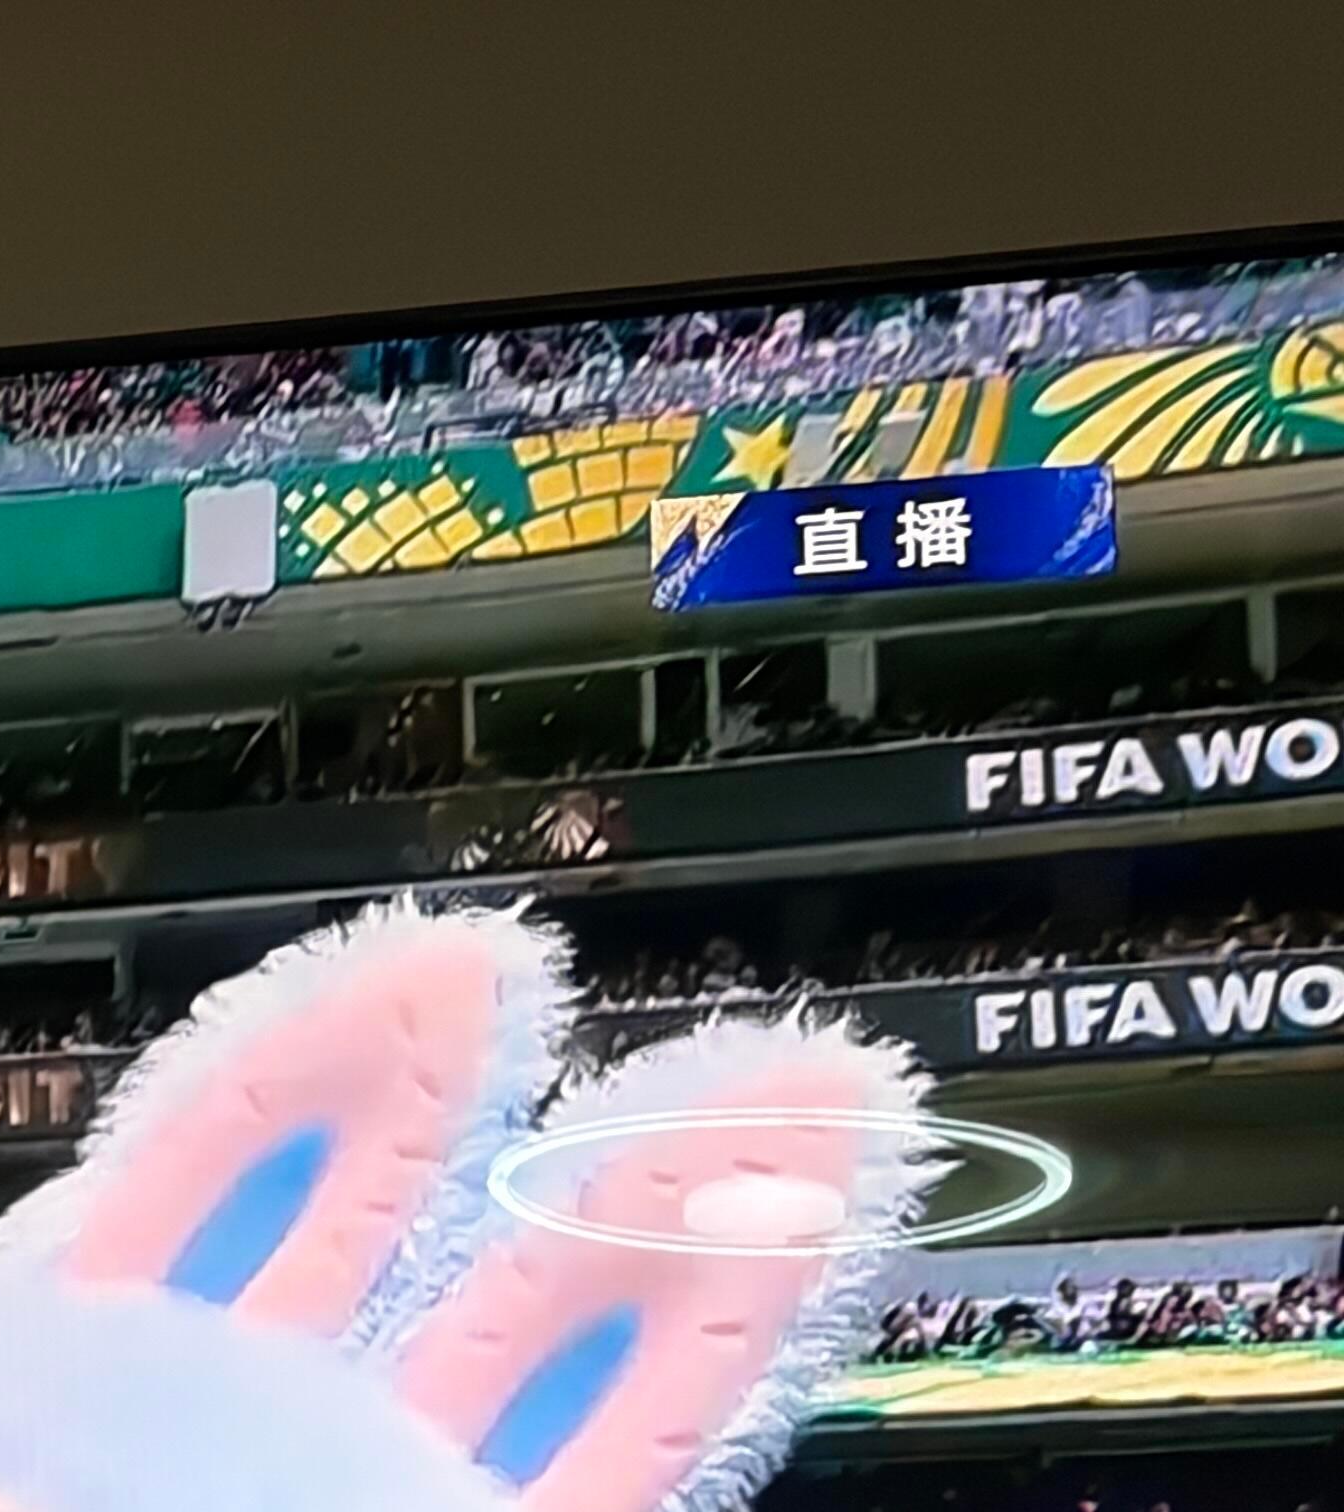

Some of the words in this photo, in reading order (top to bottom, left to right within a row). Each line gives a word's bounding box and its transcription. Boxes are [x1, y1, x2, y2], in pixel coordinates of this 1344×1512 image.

[793, 496, 974, 577] 直播
[965, 737, 1164, 811] FIFA
[975, 980, 1177, 1053] FIFA
